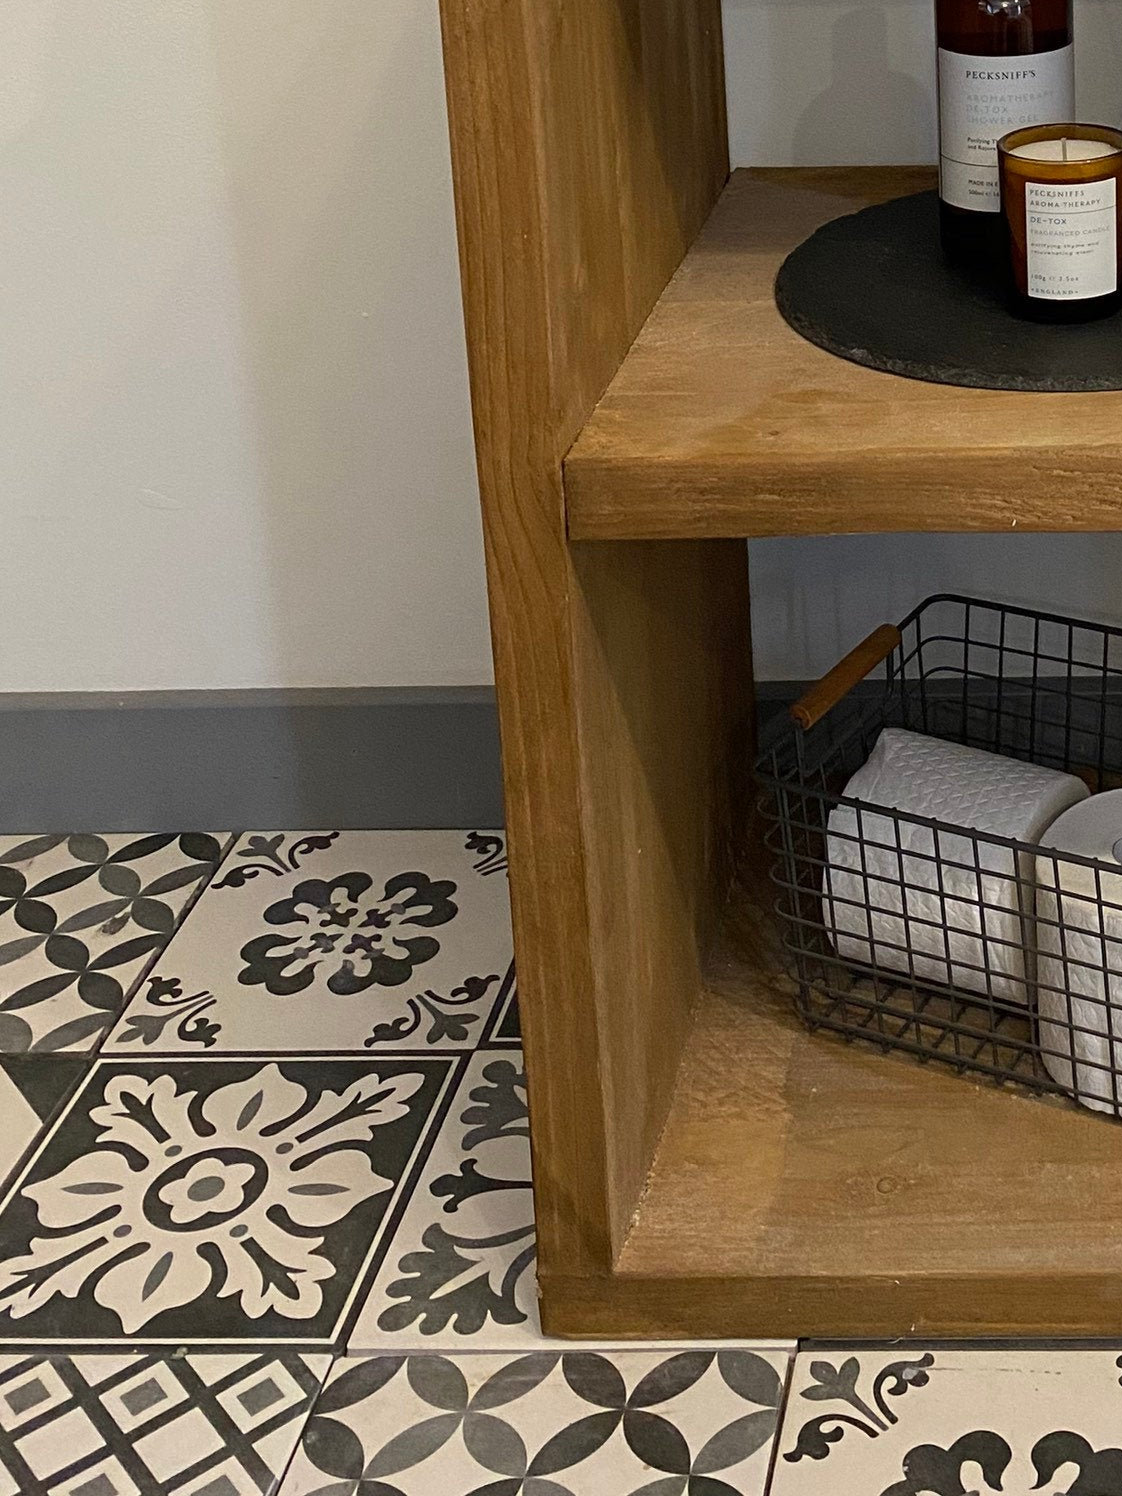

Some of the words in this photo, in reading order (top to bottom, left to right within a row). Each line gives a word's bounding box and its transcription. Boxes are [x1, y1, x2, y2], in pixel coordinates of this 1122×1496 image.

[965, 69, 1036, 81] PECKSNIFF'S
[1030, 200, 1060, 208] AROMA
[1063, 198, 1101, 208] THERAPY
[1030, 216, 1067, 225] DE-TOX
